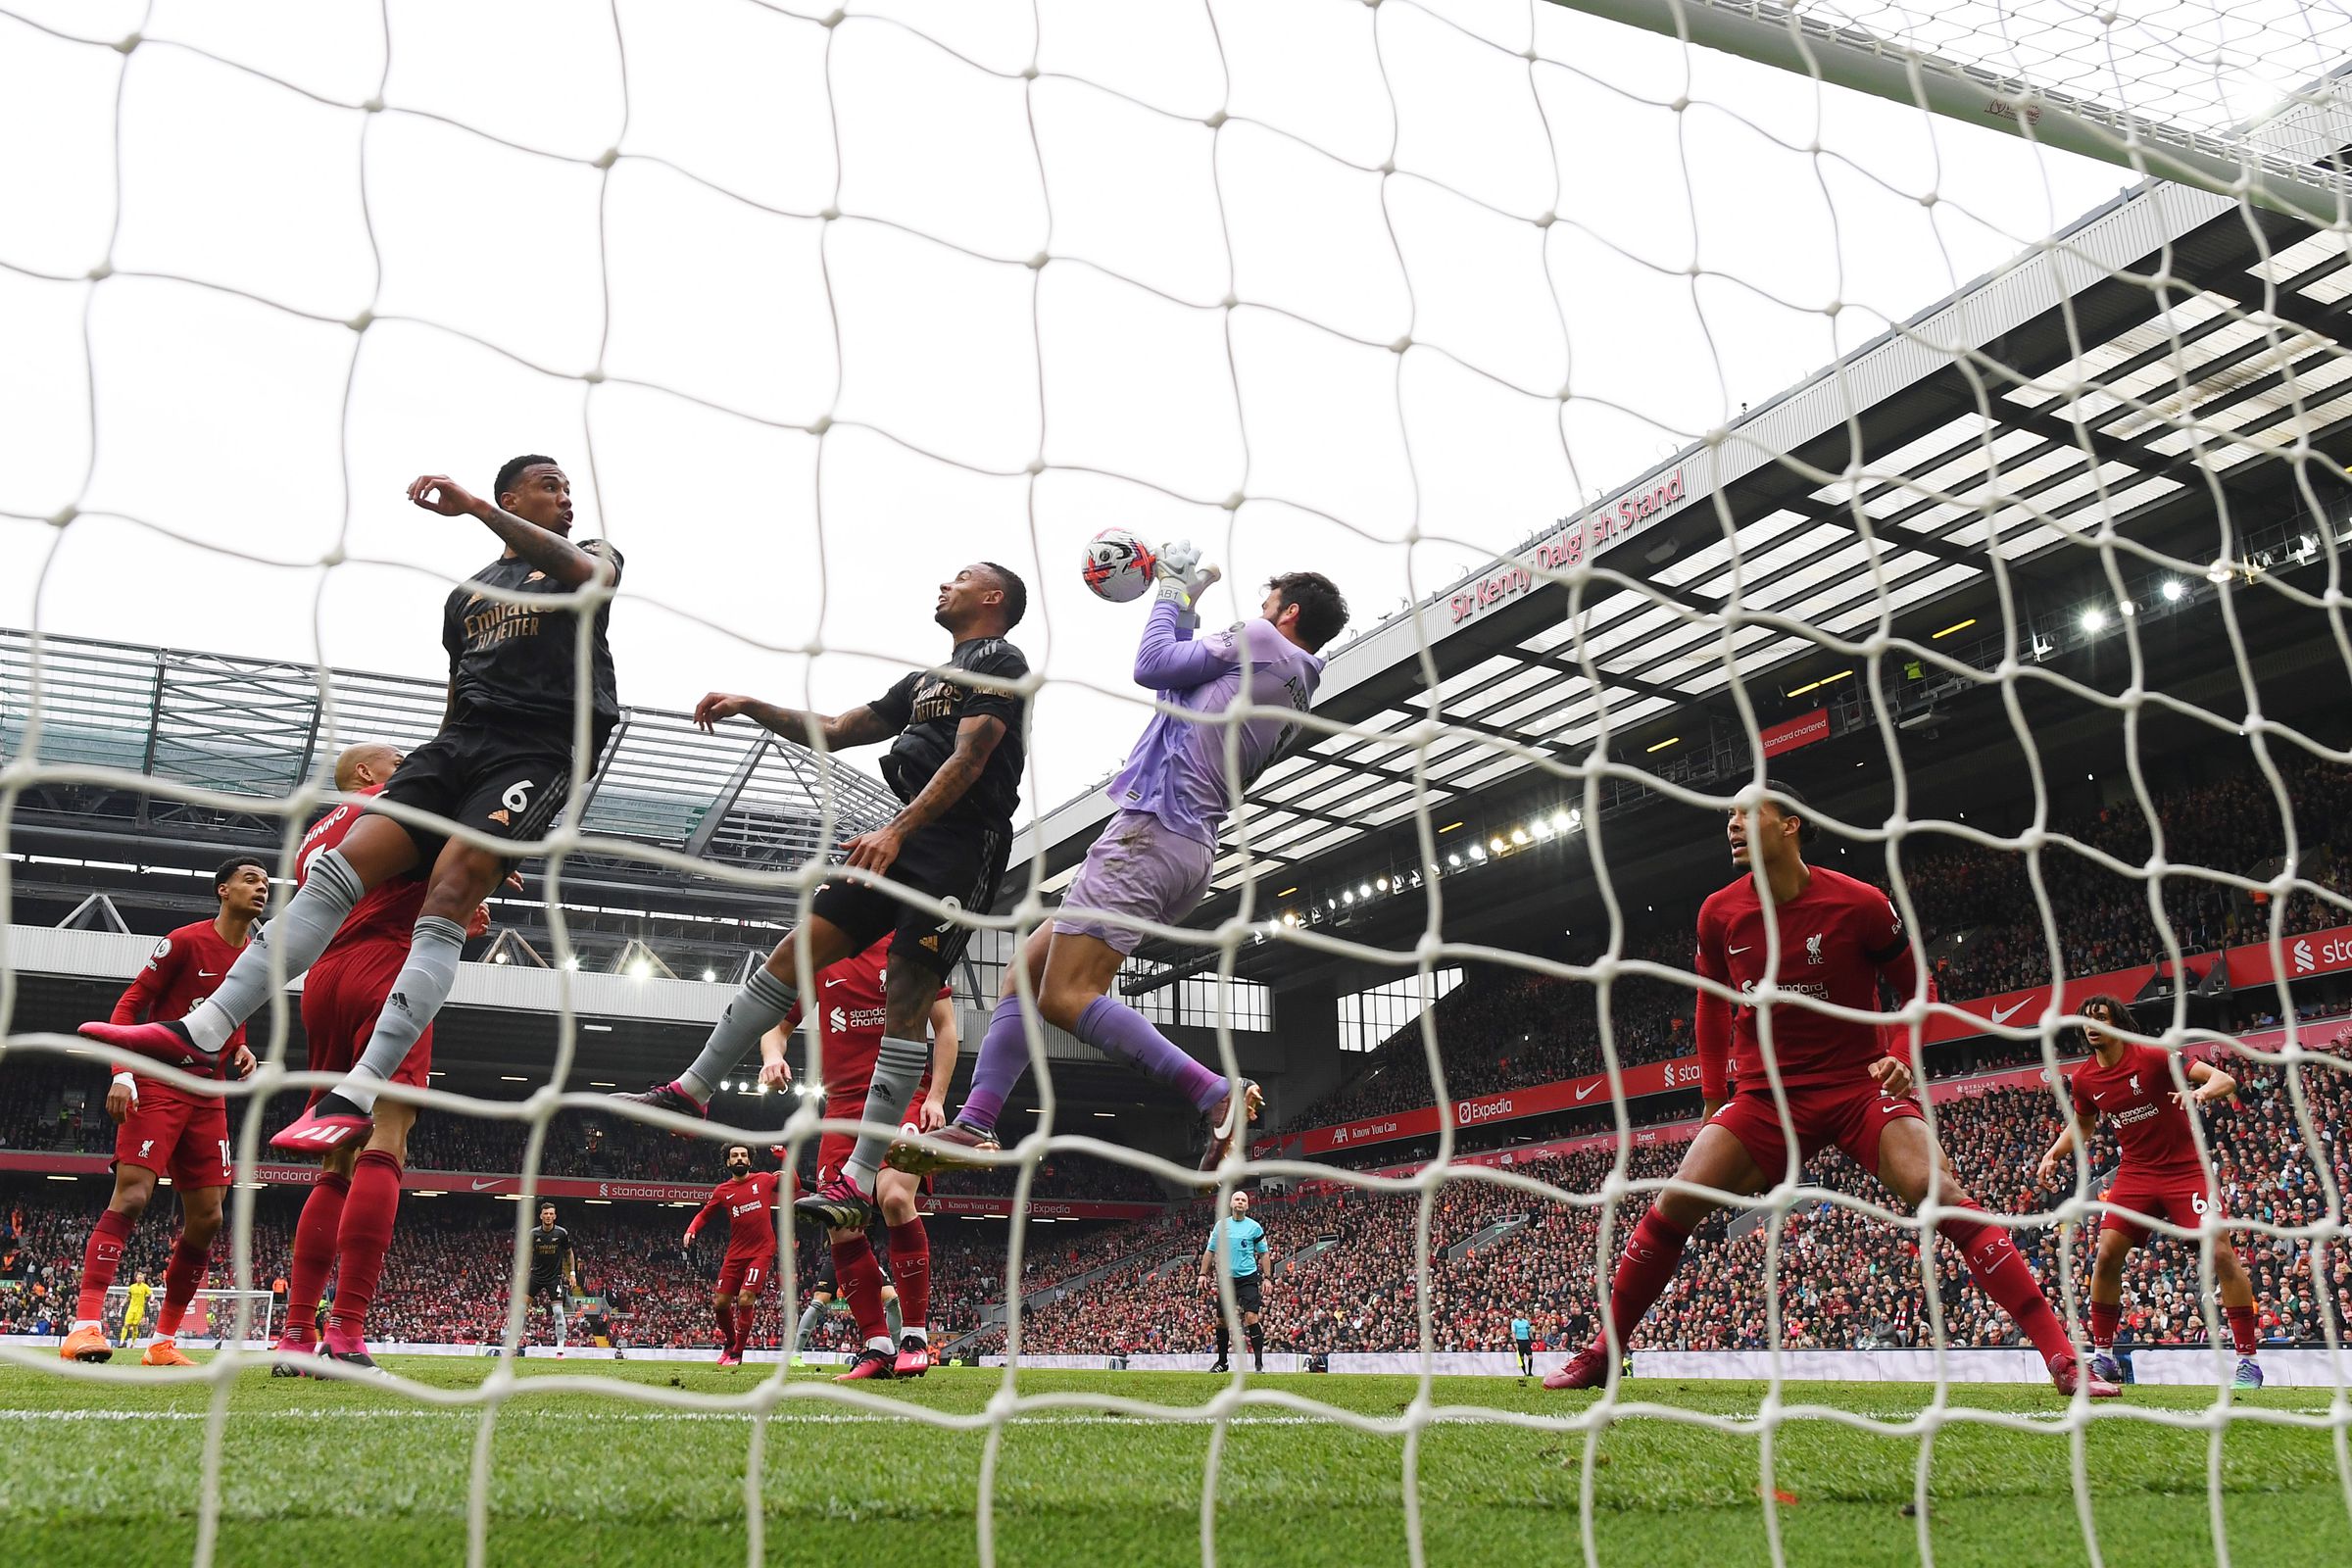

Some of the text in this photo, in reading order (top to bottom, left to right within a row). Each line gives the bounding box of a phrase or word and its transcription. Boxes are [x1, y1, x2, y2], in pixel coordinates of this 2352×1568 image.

[1449, 468, 1686, 623] Sir Kenny Dalglsh Stand
[1157, 589, 1178, 600] AB1
[1764, 718, 1826, 748] standard chartered
[502, 779, 535, 813] 6
[296, 806, 348, 858] BINHO
[934, 895, 961, 933] 9
[1776, 981, 1824, 994] andard
[850, 1006, 886, 1019] standa
[850, 1016, 885, 1027] charte
[1472, 1098, 1512, 1120] Expedia
[2119, 1102, 2153, 1119] standard
[2122, 1107, 2159, 1125] chartered
[1331, 1122, 1396, 1145] AXA Know You Can
[253, 1169, 312, 1181] standard
[612, 1186, 713, 1200] standard chartere
[922, 1199, 943, 1210] AXA
[1033, 1203, 1071, 1214] Expedia
[748, 1267, 760, 1283] 11
[556, 1284, 562, 1298] 4
